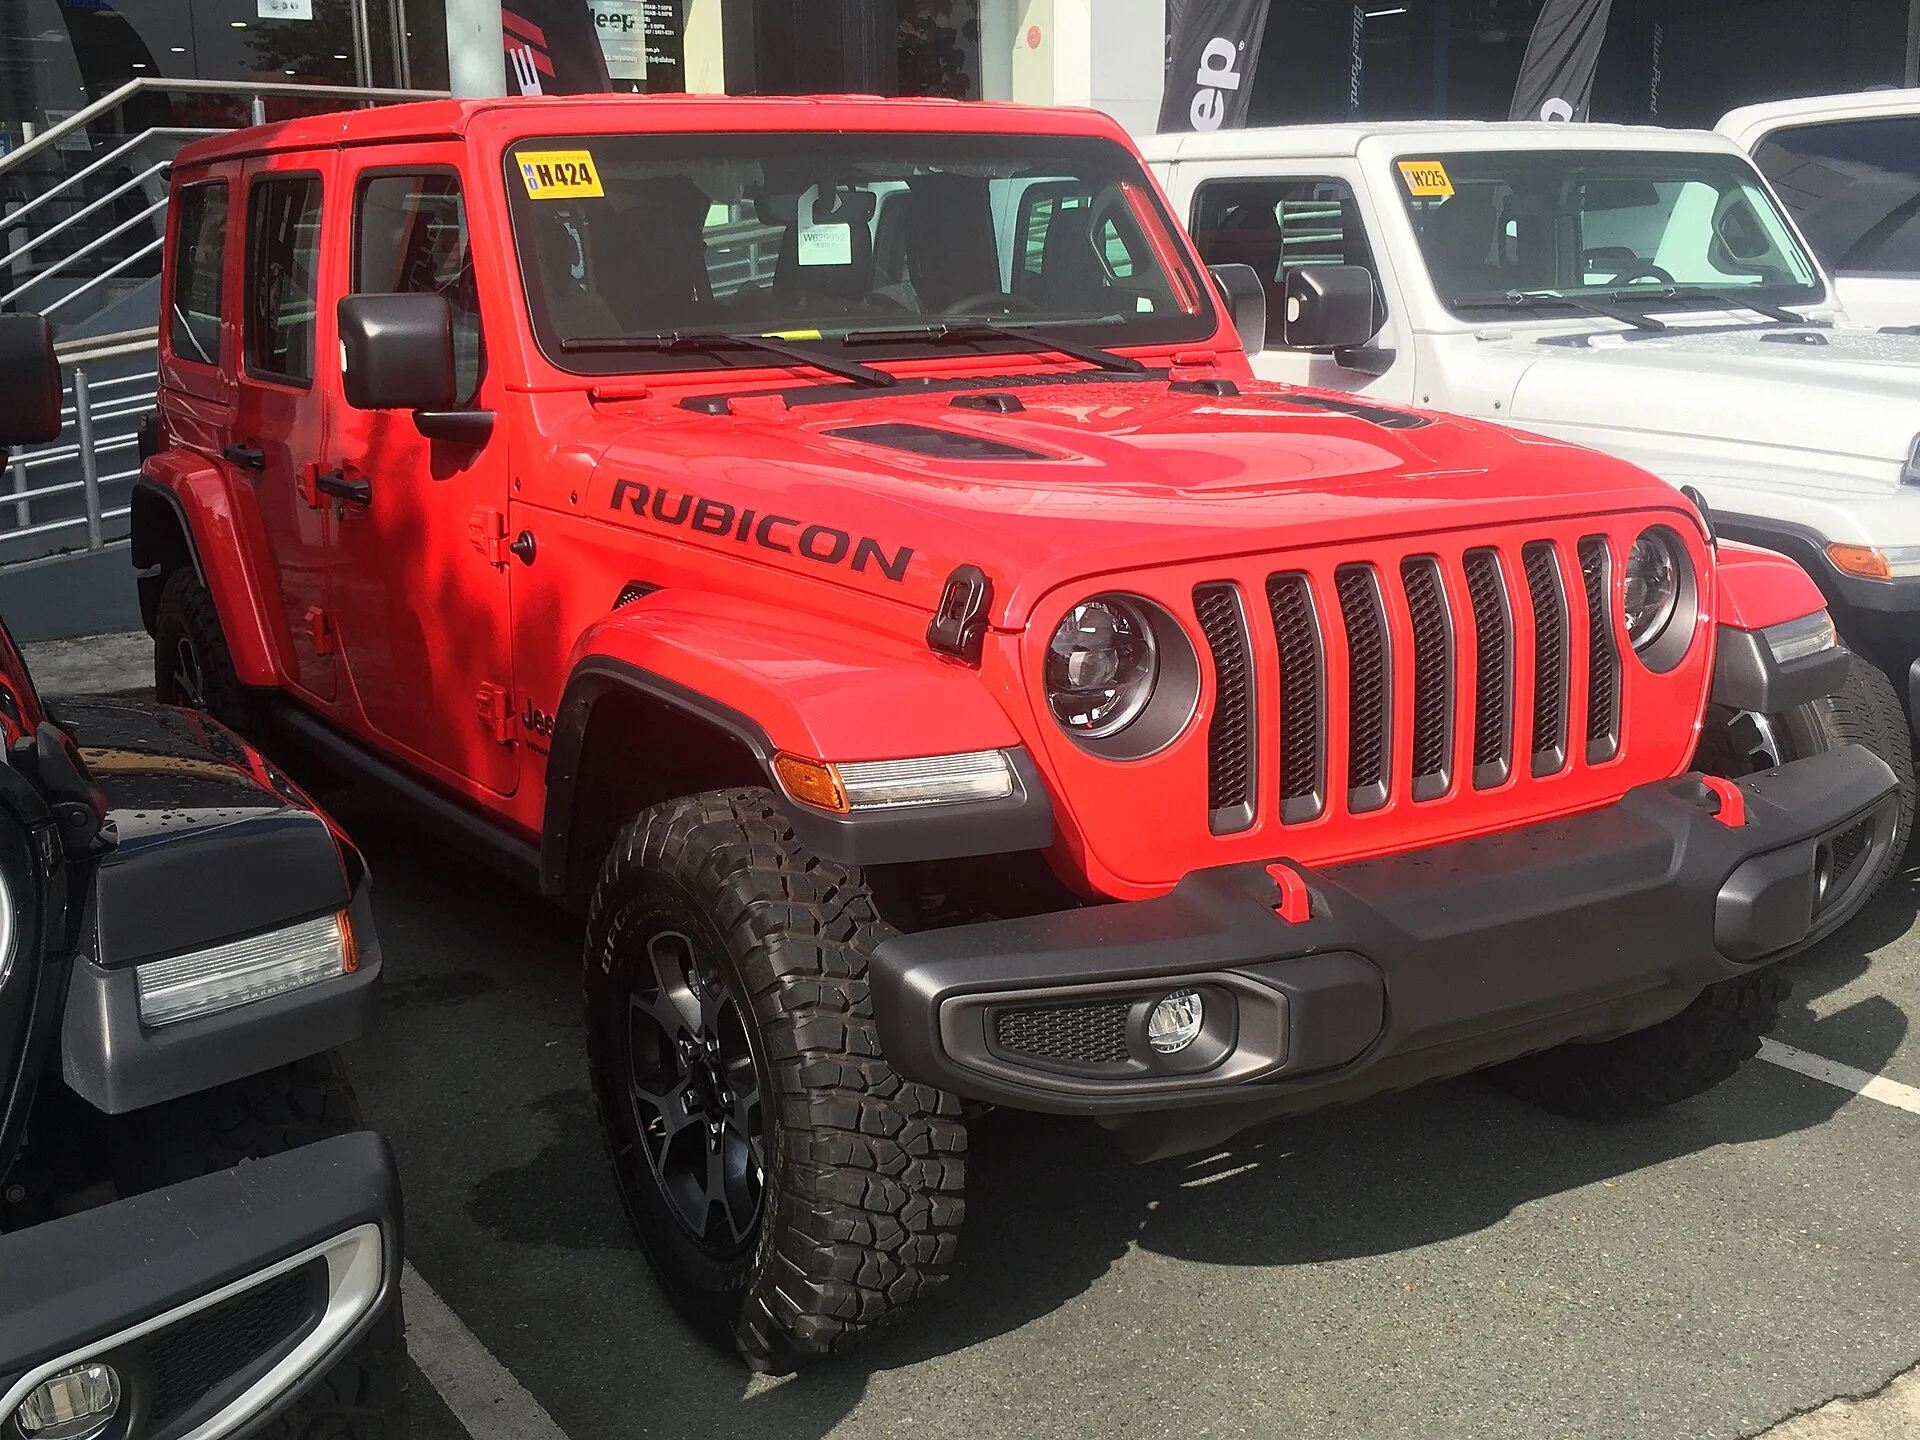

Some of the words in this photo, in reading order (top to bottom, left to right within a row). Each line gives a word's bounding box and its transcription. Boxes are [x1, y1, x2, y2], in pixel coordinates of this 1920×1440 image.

[535, 162, 593, 187] H424
[1411, 170, 1446, 187] H225
[610, 478, 915, 584] RUBICON
